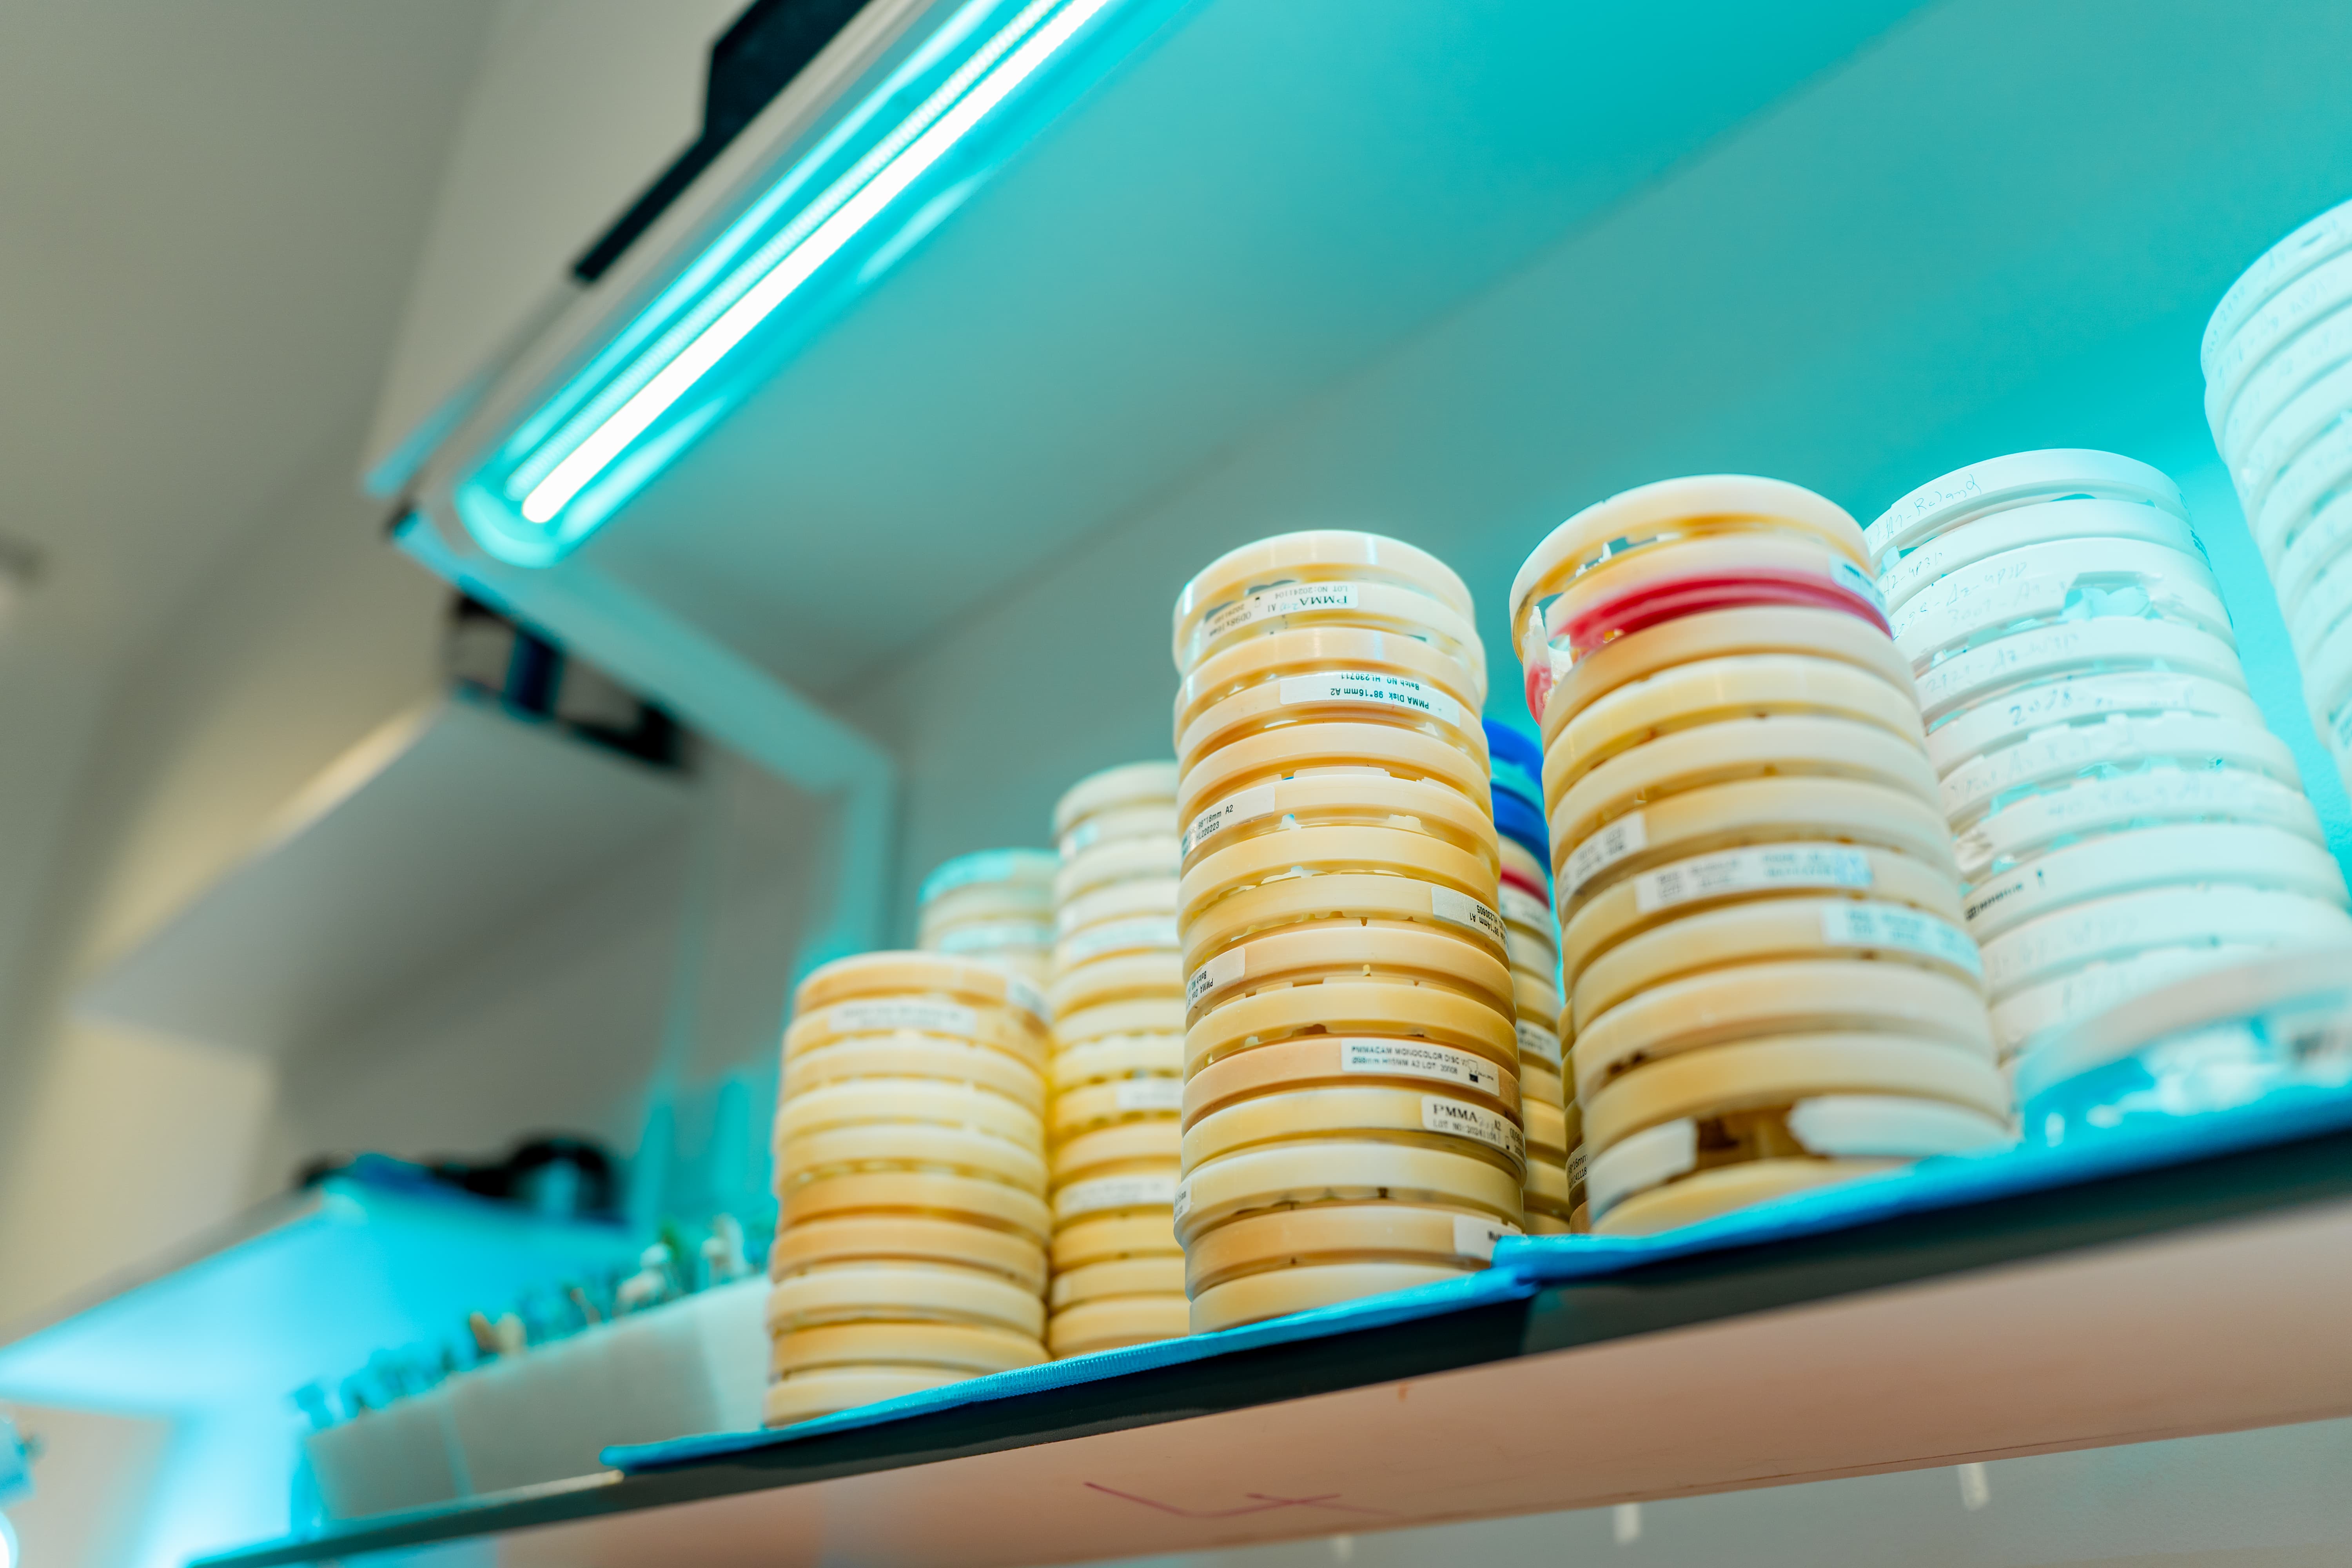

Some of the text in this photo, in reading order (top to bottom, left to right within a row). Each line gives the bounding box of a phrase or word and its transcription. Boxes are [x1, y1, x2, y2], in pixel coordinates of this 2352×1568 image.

[1299, 595, 1348, 606] PMMA
[1400, 679, 1419, 691] Batch
[1407, 695, 1429, 709] PMMA
[1225, 804, 1233, 815] A2
[1196, 821, 1219, 841] HL220223
[1470, 912, 1476, 922] A1
[1477, 905, 1497, 924] HL230605
[1196, 971, 1207, 985] Batch
[1200, 978, 1213, 993] PMMA
[1394, 1048, 1442, 1060] MONOCOLOR
[1433, 1103, 1478, 1123] PMMA
